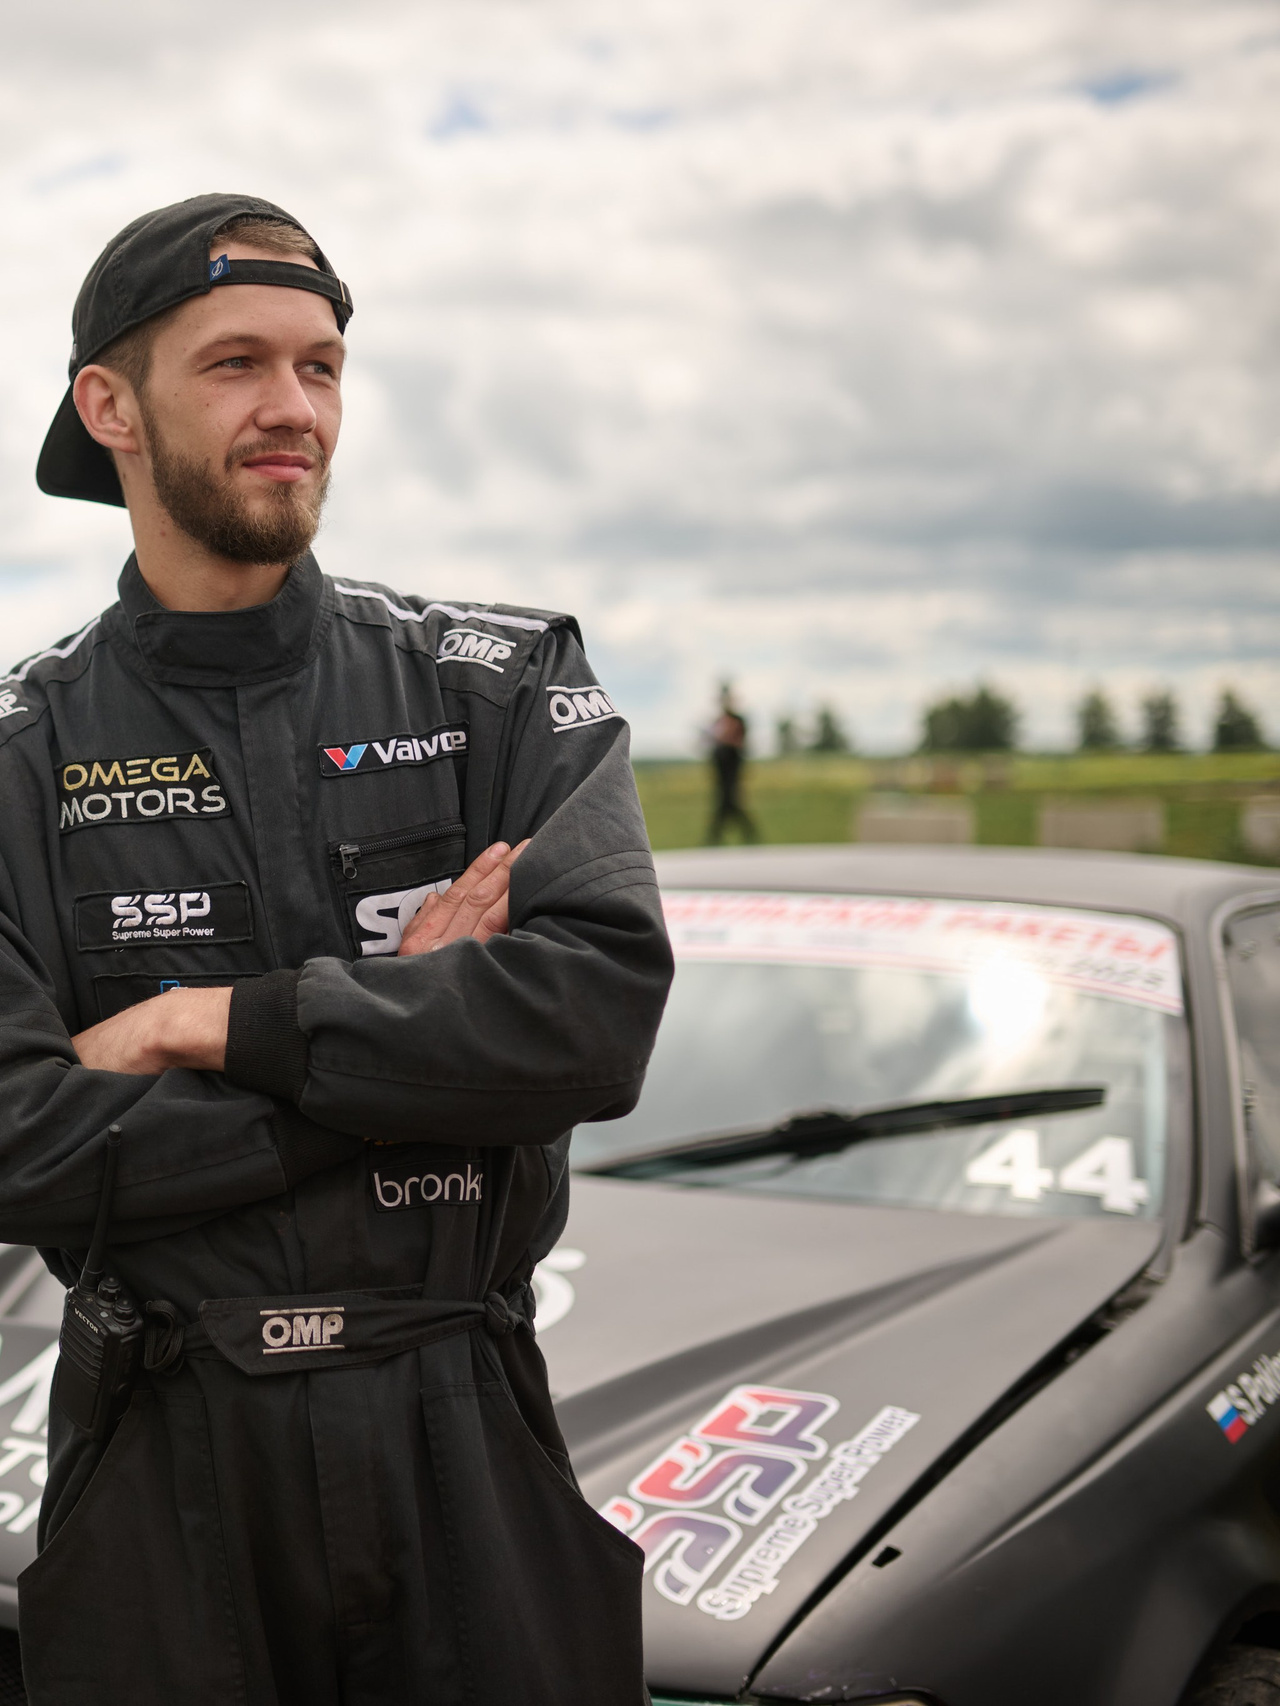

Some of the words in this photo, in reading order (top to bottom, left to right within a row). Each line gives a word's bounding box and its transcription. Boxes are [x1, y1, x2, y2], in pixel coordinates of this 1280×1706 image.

[437, 633, 512, 663] OMP
[63, 753, 211, 791] OMEGA
[58, 784, 227, 829] MOTORS
[110, 892, 211, 929] SSP
[111, 931, 152, 942] Supreme
[152, 927, 181, 939] Super
[182, 926, 215, 937] Power
[966, 1128, 1150, 1216] 44
[74, 1307, 99, 1335] VECTOR
[261, 1313, 345, 1348] OMP
[697, 1512, 818, 1621] Supreme
[781, 1455, 860, 1520] Super
[830, 1405, 921, 1467] Power
